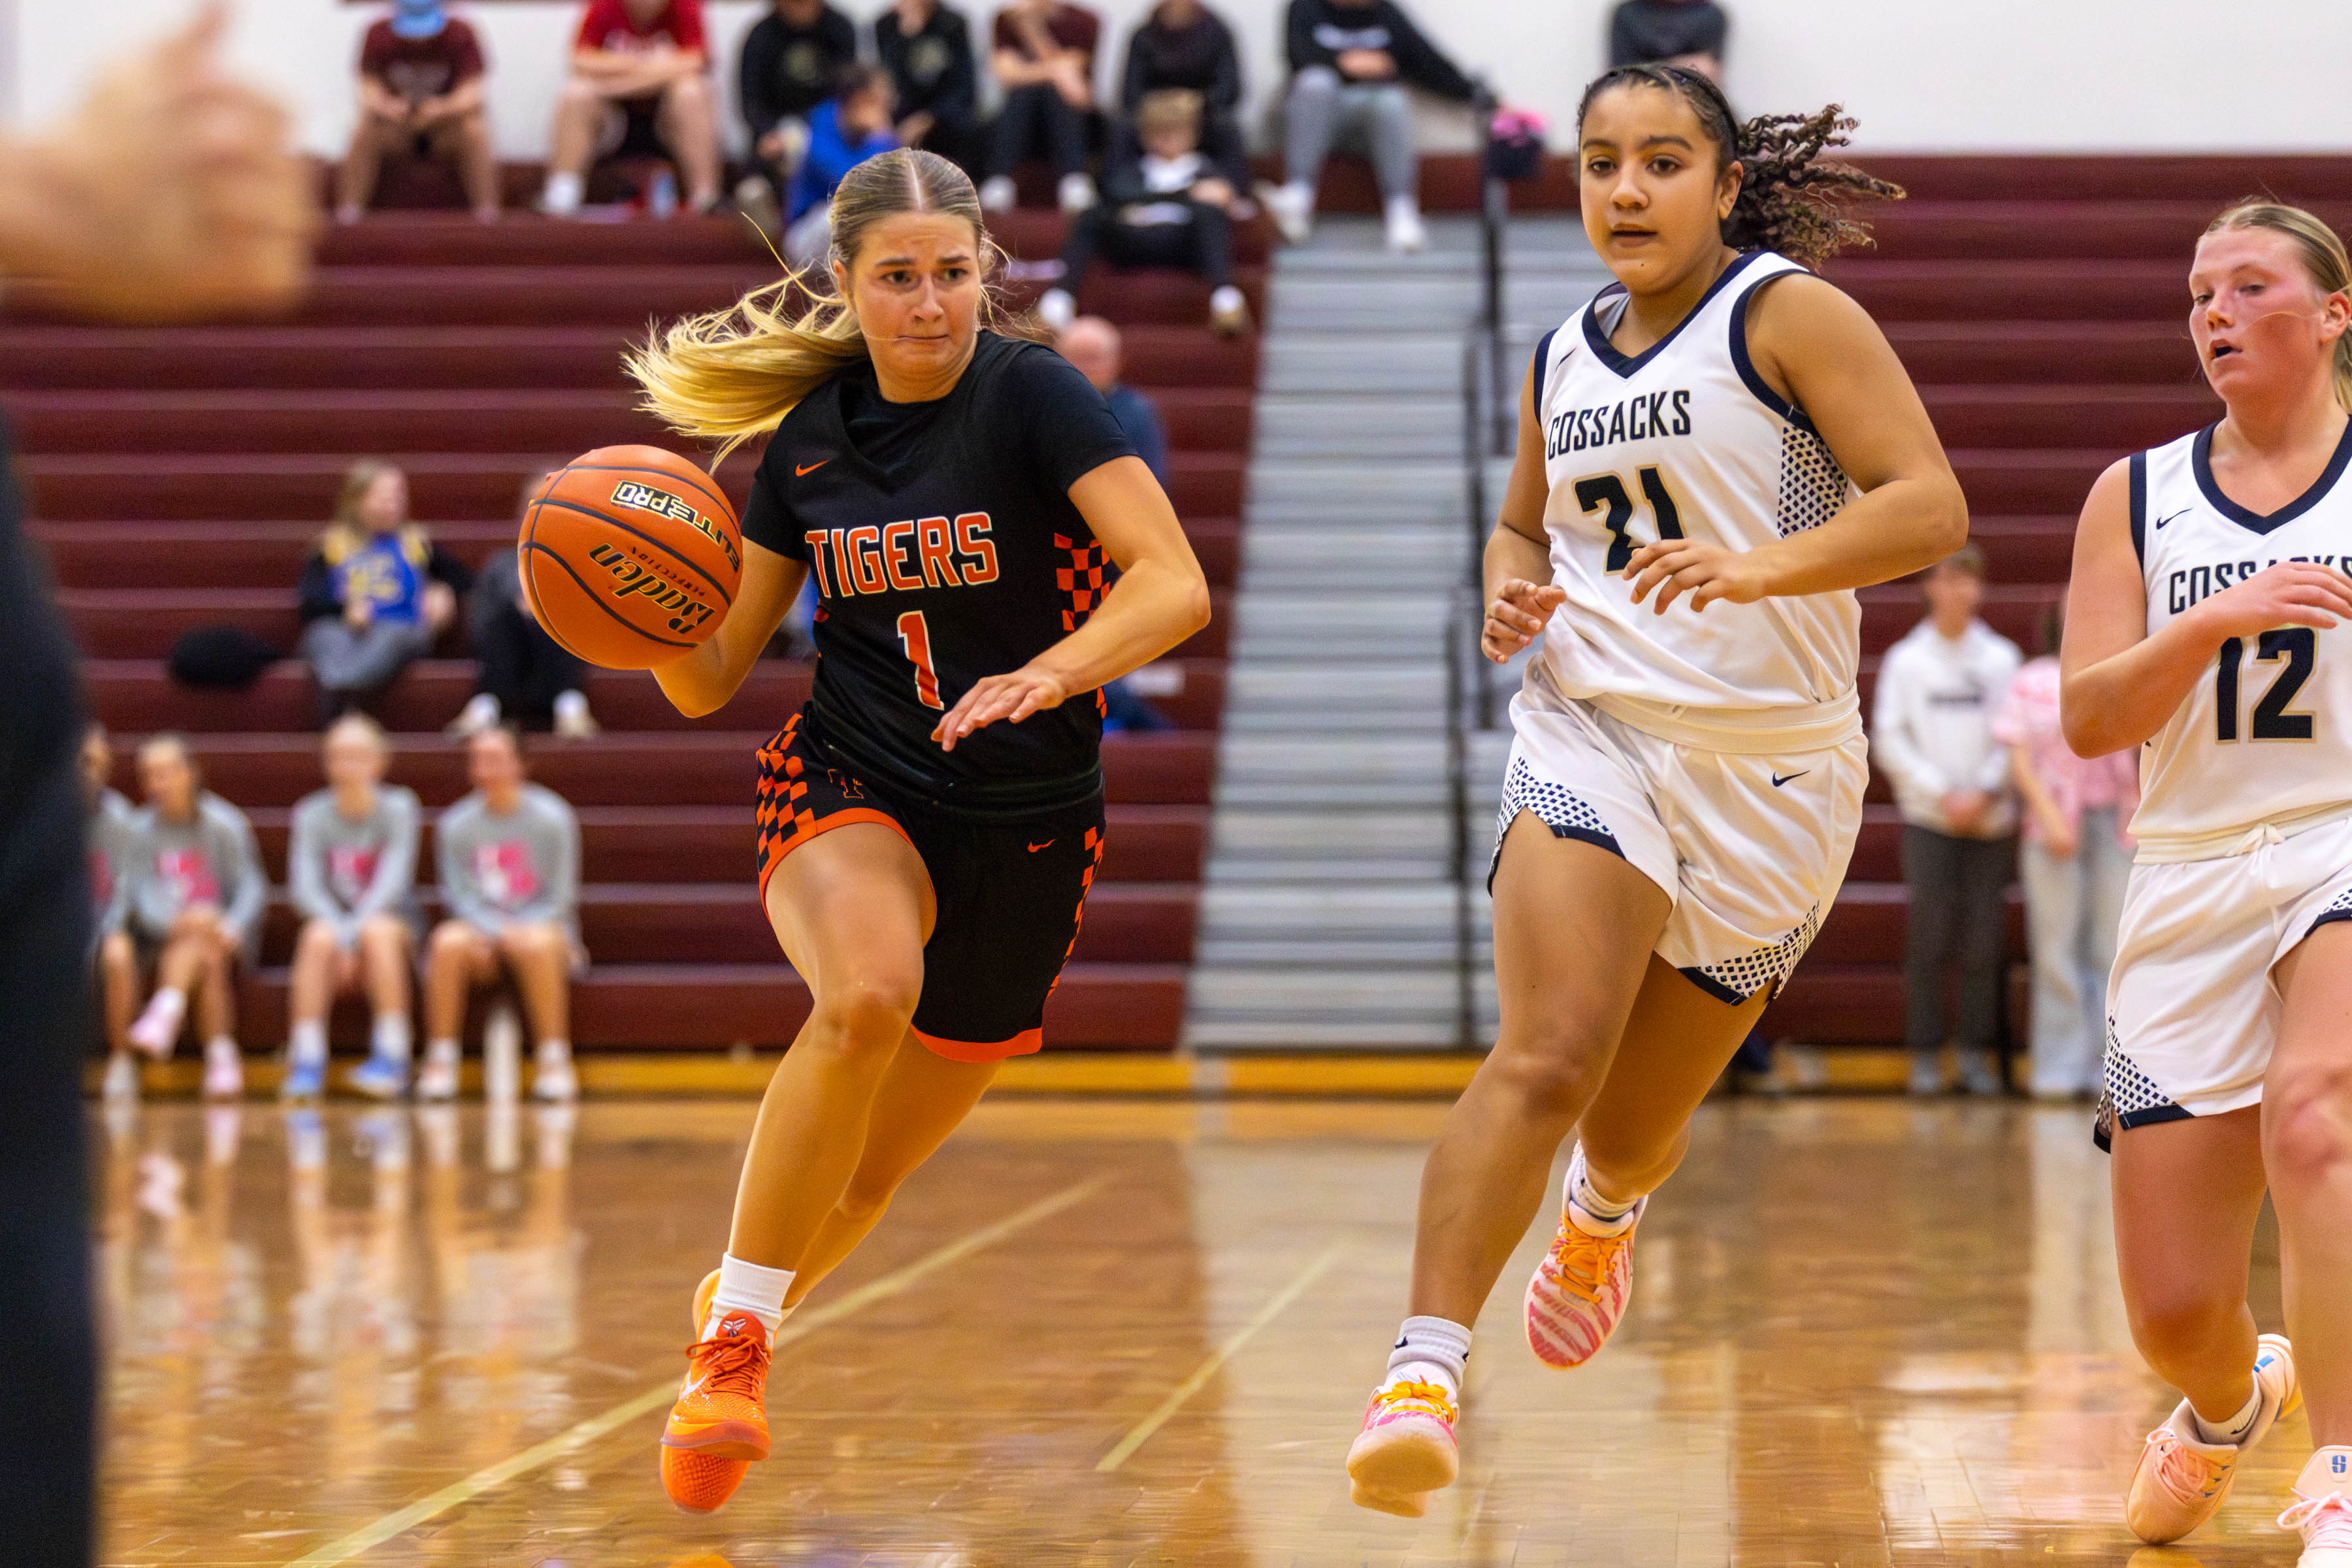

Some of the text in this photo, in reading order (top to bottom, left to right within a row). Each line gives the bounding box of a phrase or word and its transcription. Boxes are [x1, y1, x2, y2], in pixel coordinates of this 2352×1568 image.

[1548, 389, 1691, 460] COSSACKS
[616, 484, 740, 573] ELITE PRO
[805, 511, 1000, 598] TIGERS
[1571, 463, 1688, 576] 21
[588, 543, 716, 634] Baden
[896, 610, 945, 711] 1
[2214, 626, 2319, 745] 12
